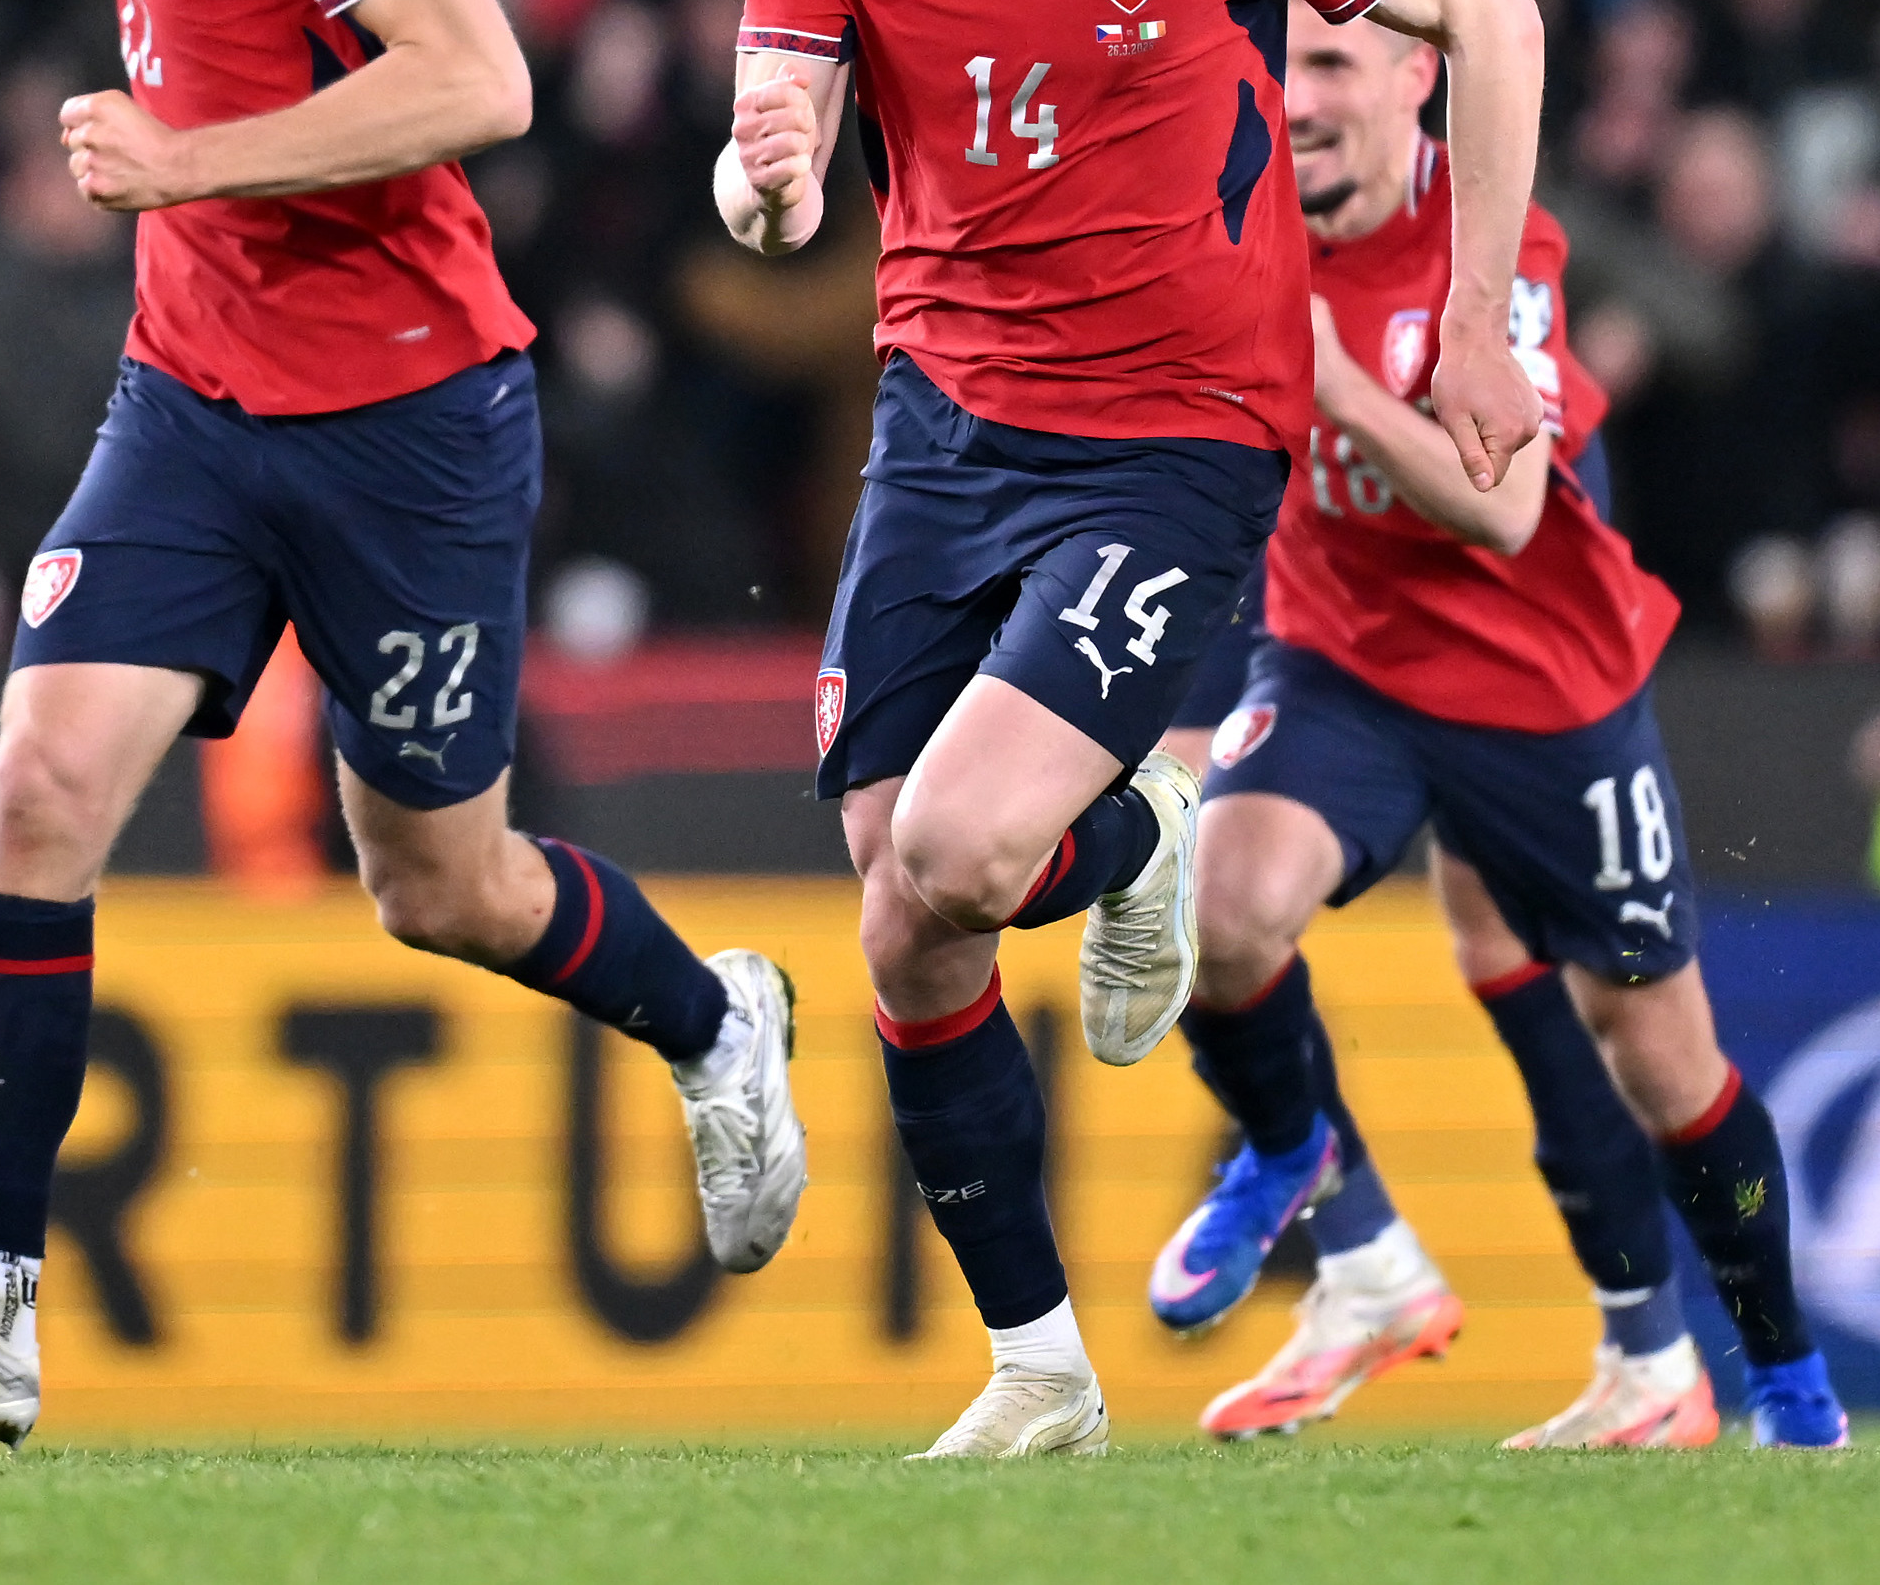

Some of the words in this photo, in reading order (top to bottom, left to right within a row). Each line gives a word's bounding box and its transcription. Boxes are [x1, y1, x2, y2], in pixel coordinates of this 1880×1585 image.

[963, 56, 1060, 170] 14
[1058, 543, 1189, 666] 14
[370, 621, 479, 729] 22
[1584, 764, 1674, 890] 18
[916, 1180, 986, 1203] CZE
